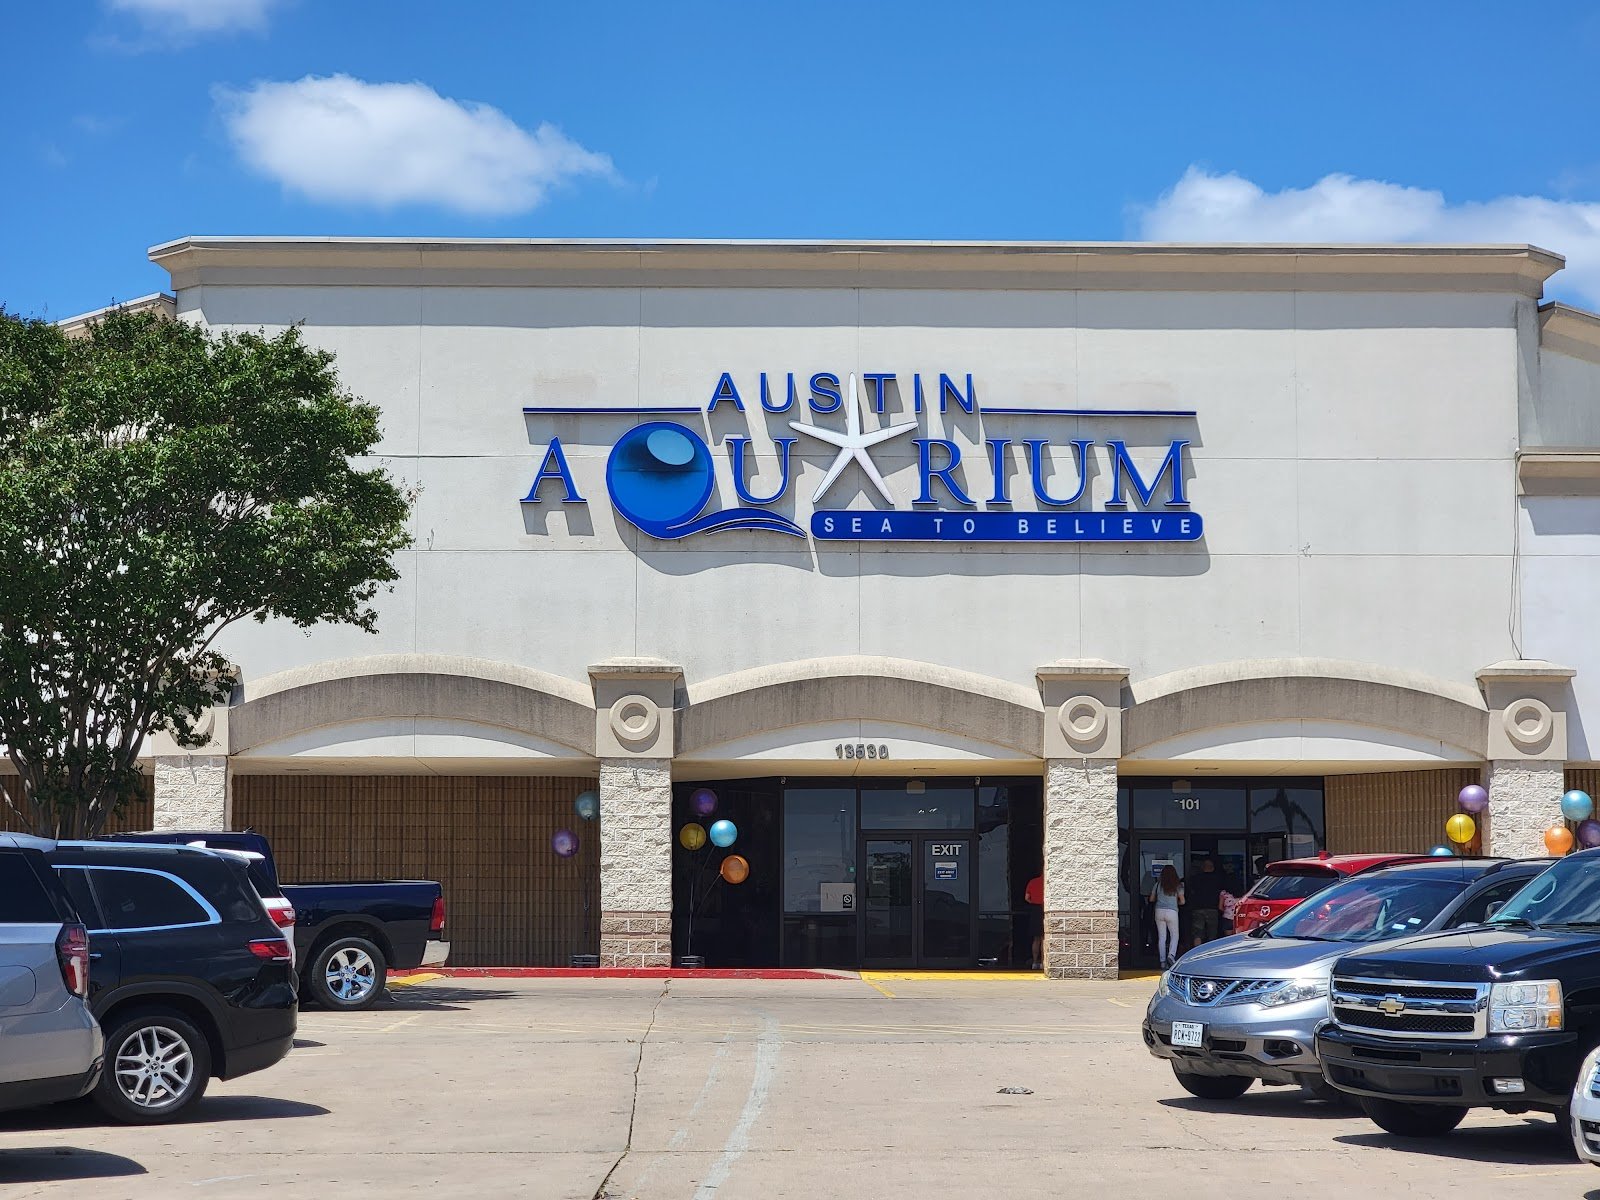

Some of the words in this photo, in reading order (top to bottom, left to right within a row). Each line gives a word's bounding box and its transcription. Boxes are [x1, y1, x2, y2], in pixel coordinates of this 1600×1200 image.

[707, 371, 974, 414] AUSTIN
[823, 516, 893, 534] SEA
[933, 517, 976, 535] TO
[1017, 518, 1192, 536] BELIEVE
[835, 743, 889, 760] 13530
[1179, 798, 1200, 811] 101
[931, 844, 962, 856] EXIT
